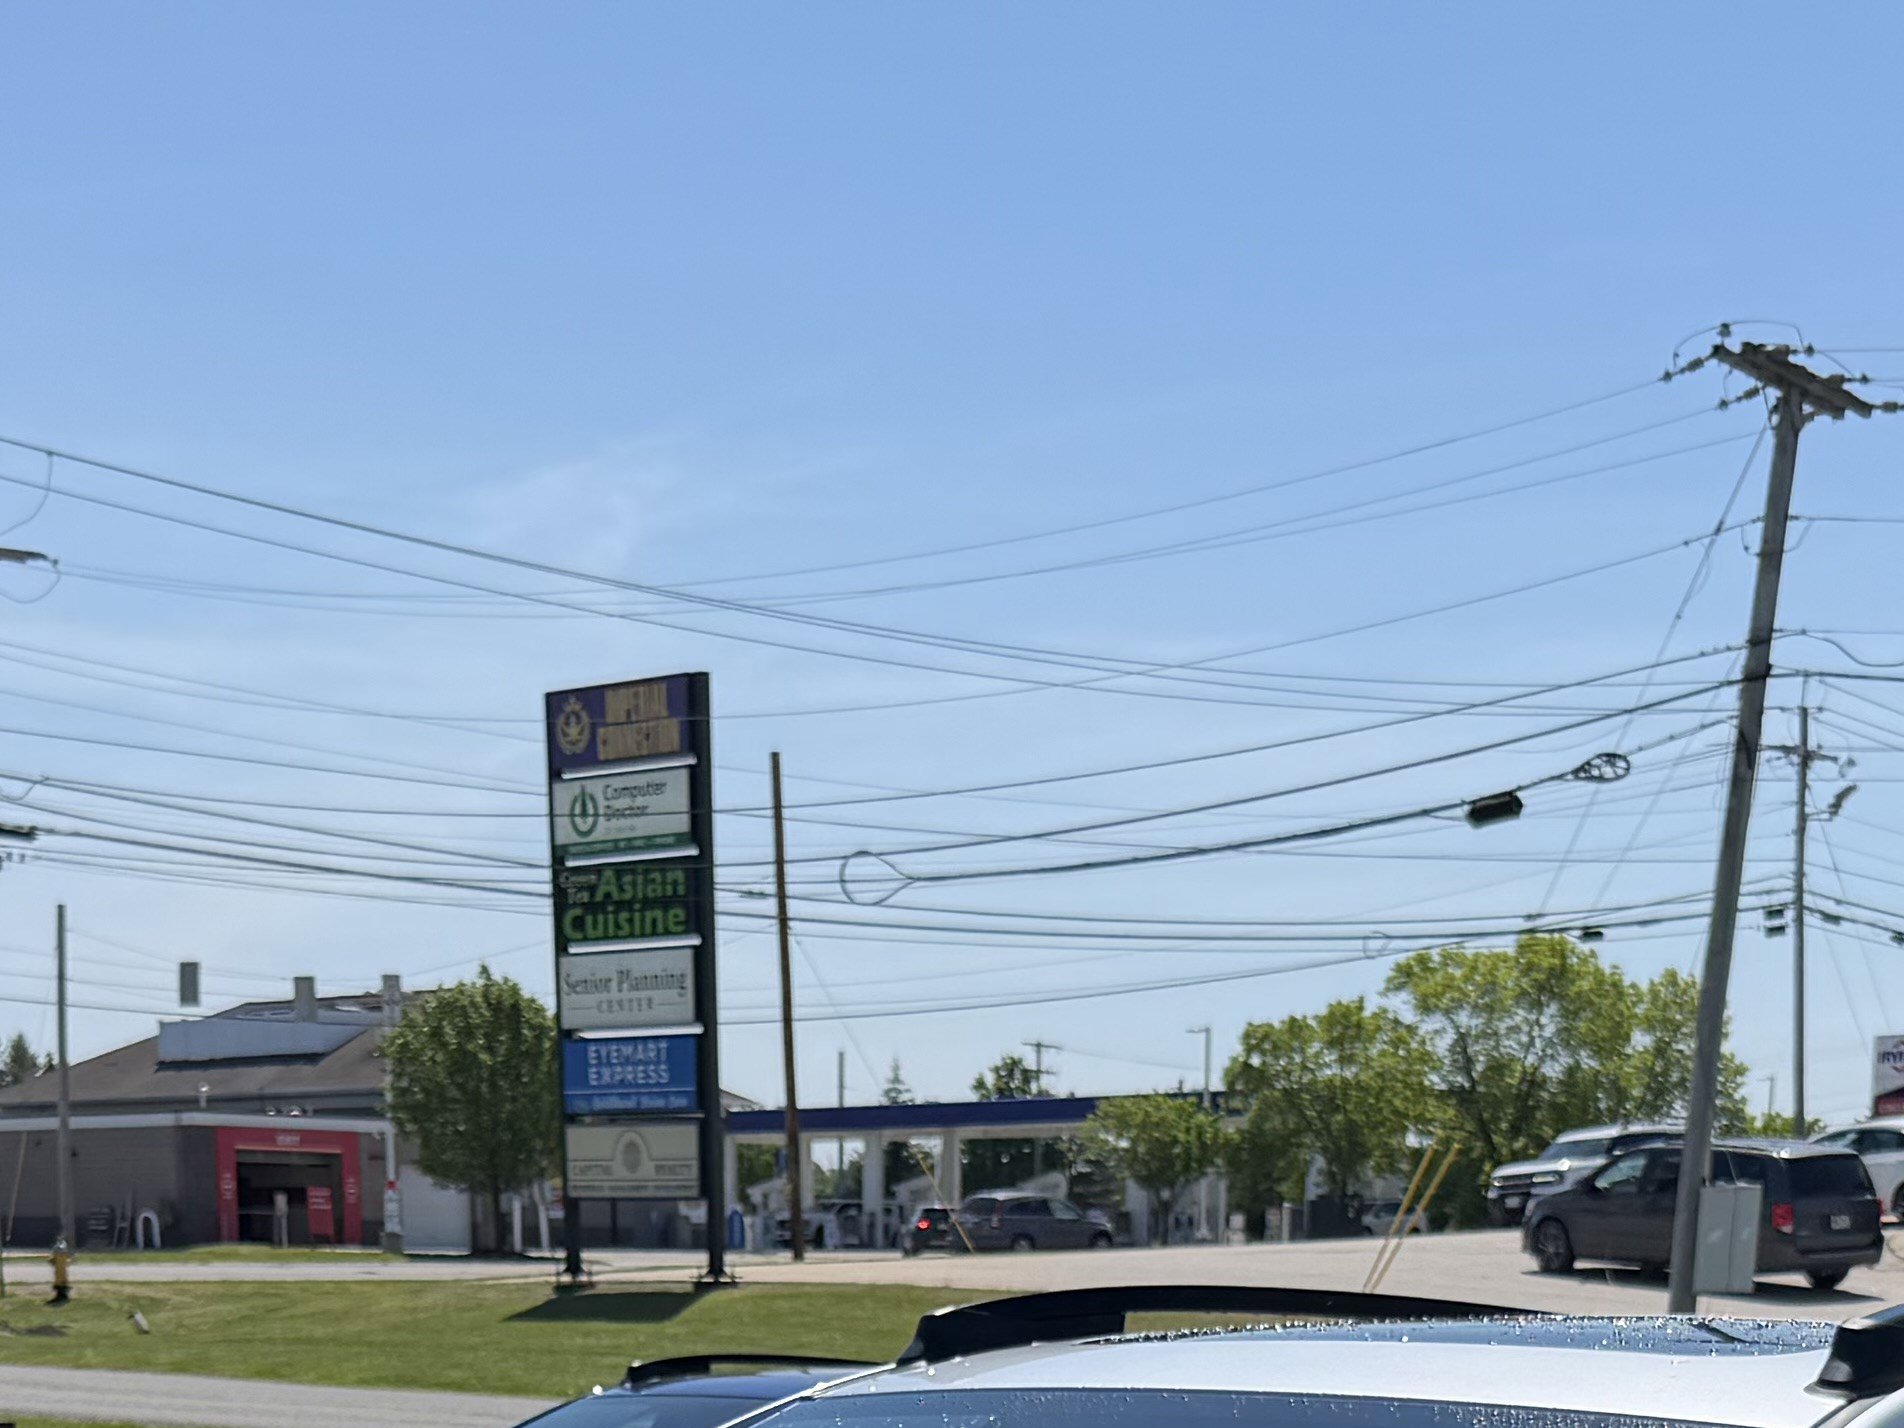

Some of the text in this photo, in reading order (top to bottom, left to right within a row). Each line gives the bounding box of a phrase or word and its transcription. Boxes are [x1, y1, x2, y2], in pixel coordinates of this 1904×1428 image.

[595, 868, 685, 901] Asian
[562, 903, 686, 940] Cuisine
[616, 968, 688, 998] Planning
[588, 1039, 668, 1065] EYEMART
[588, 1064, 670, 1086] EXPRESS
